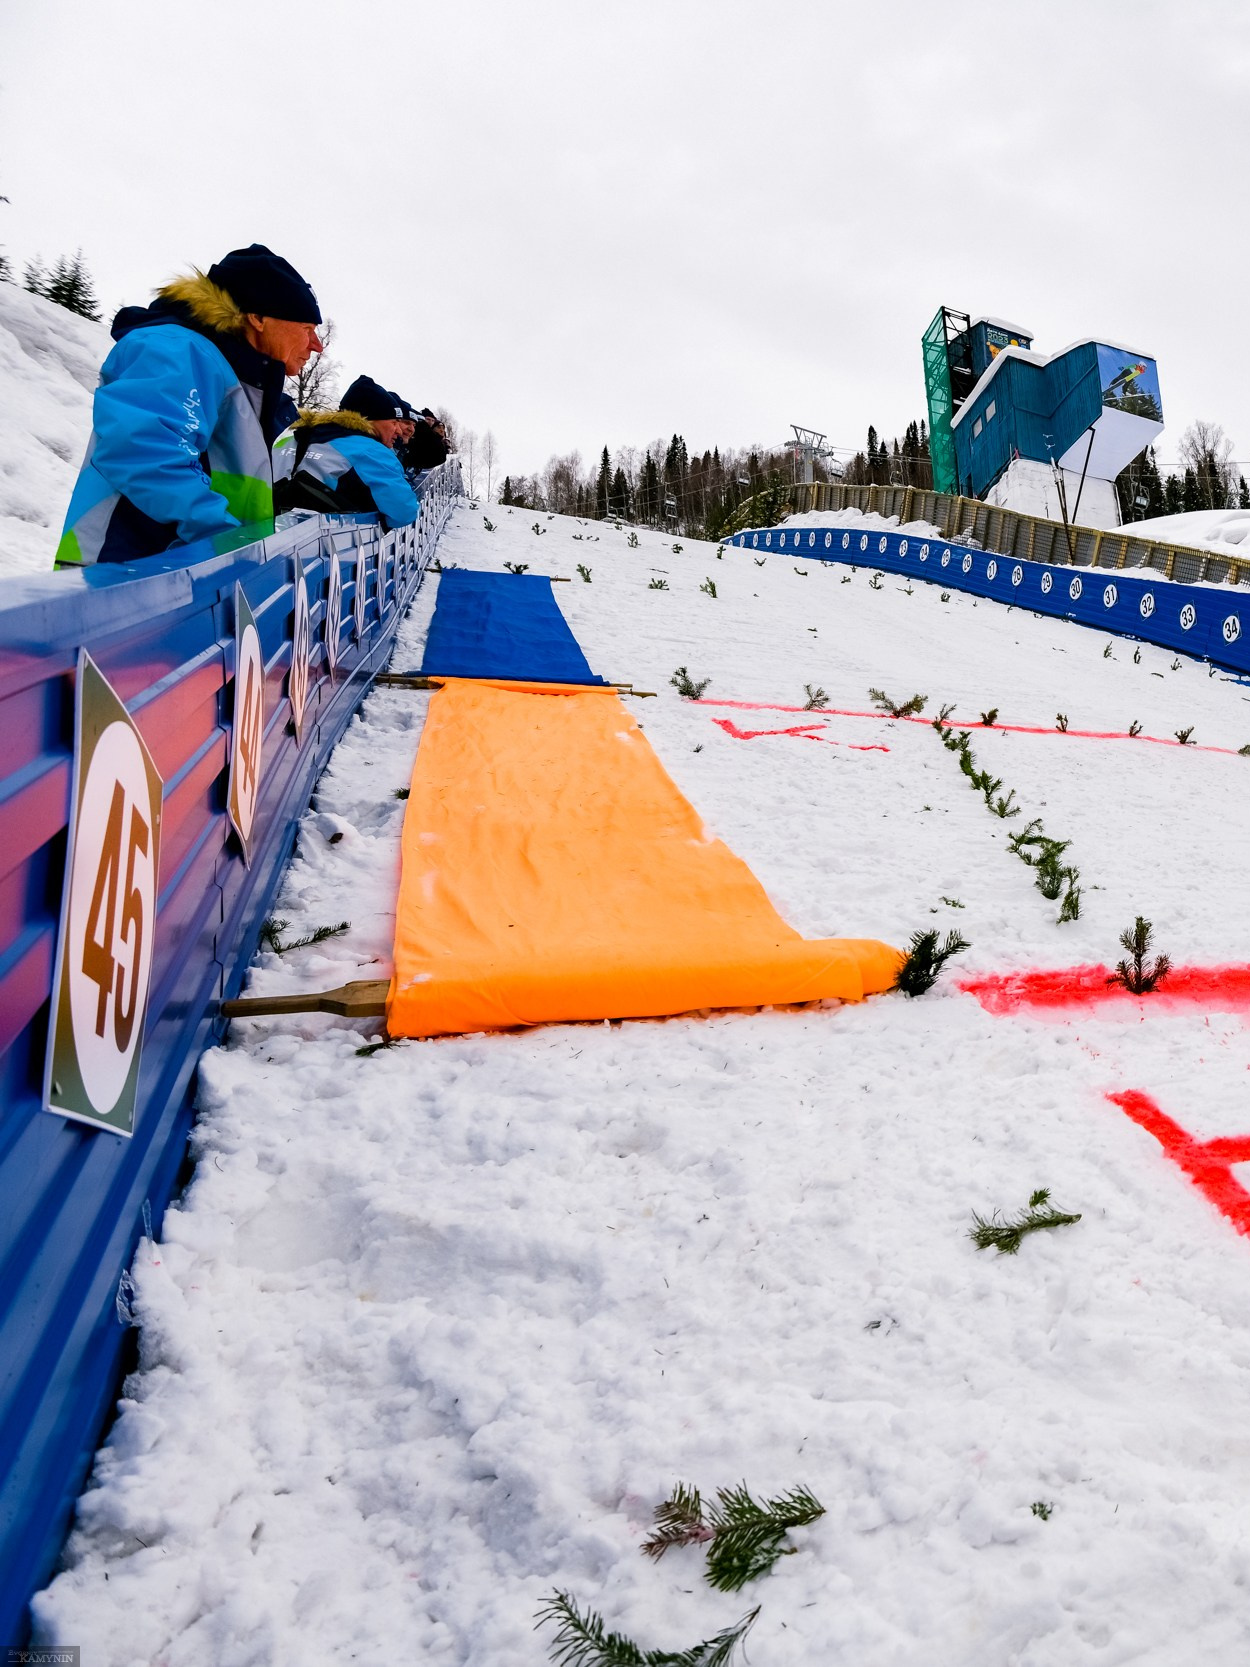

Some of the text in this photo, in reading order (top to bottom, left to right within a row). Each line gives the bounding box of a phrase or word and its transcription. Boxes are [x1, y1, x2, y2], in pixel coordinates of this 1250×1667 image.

[1013, 567, 1022, 584] 28
[1042, 573, 1051, 591] 29
[1071, 579, 1081, 598] 30
[1105, 587, 1115, 605] 31
[1142, 597, 1154, 616] 32
[1182, 607, 1194, 627] 33
[1225, 618, 1239, 640] 34
[239, 655, 261, 816] 44
[82, 780, 149, 1052] 45
